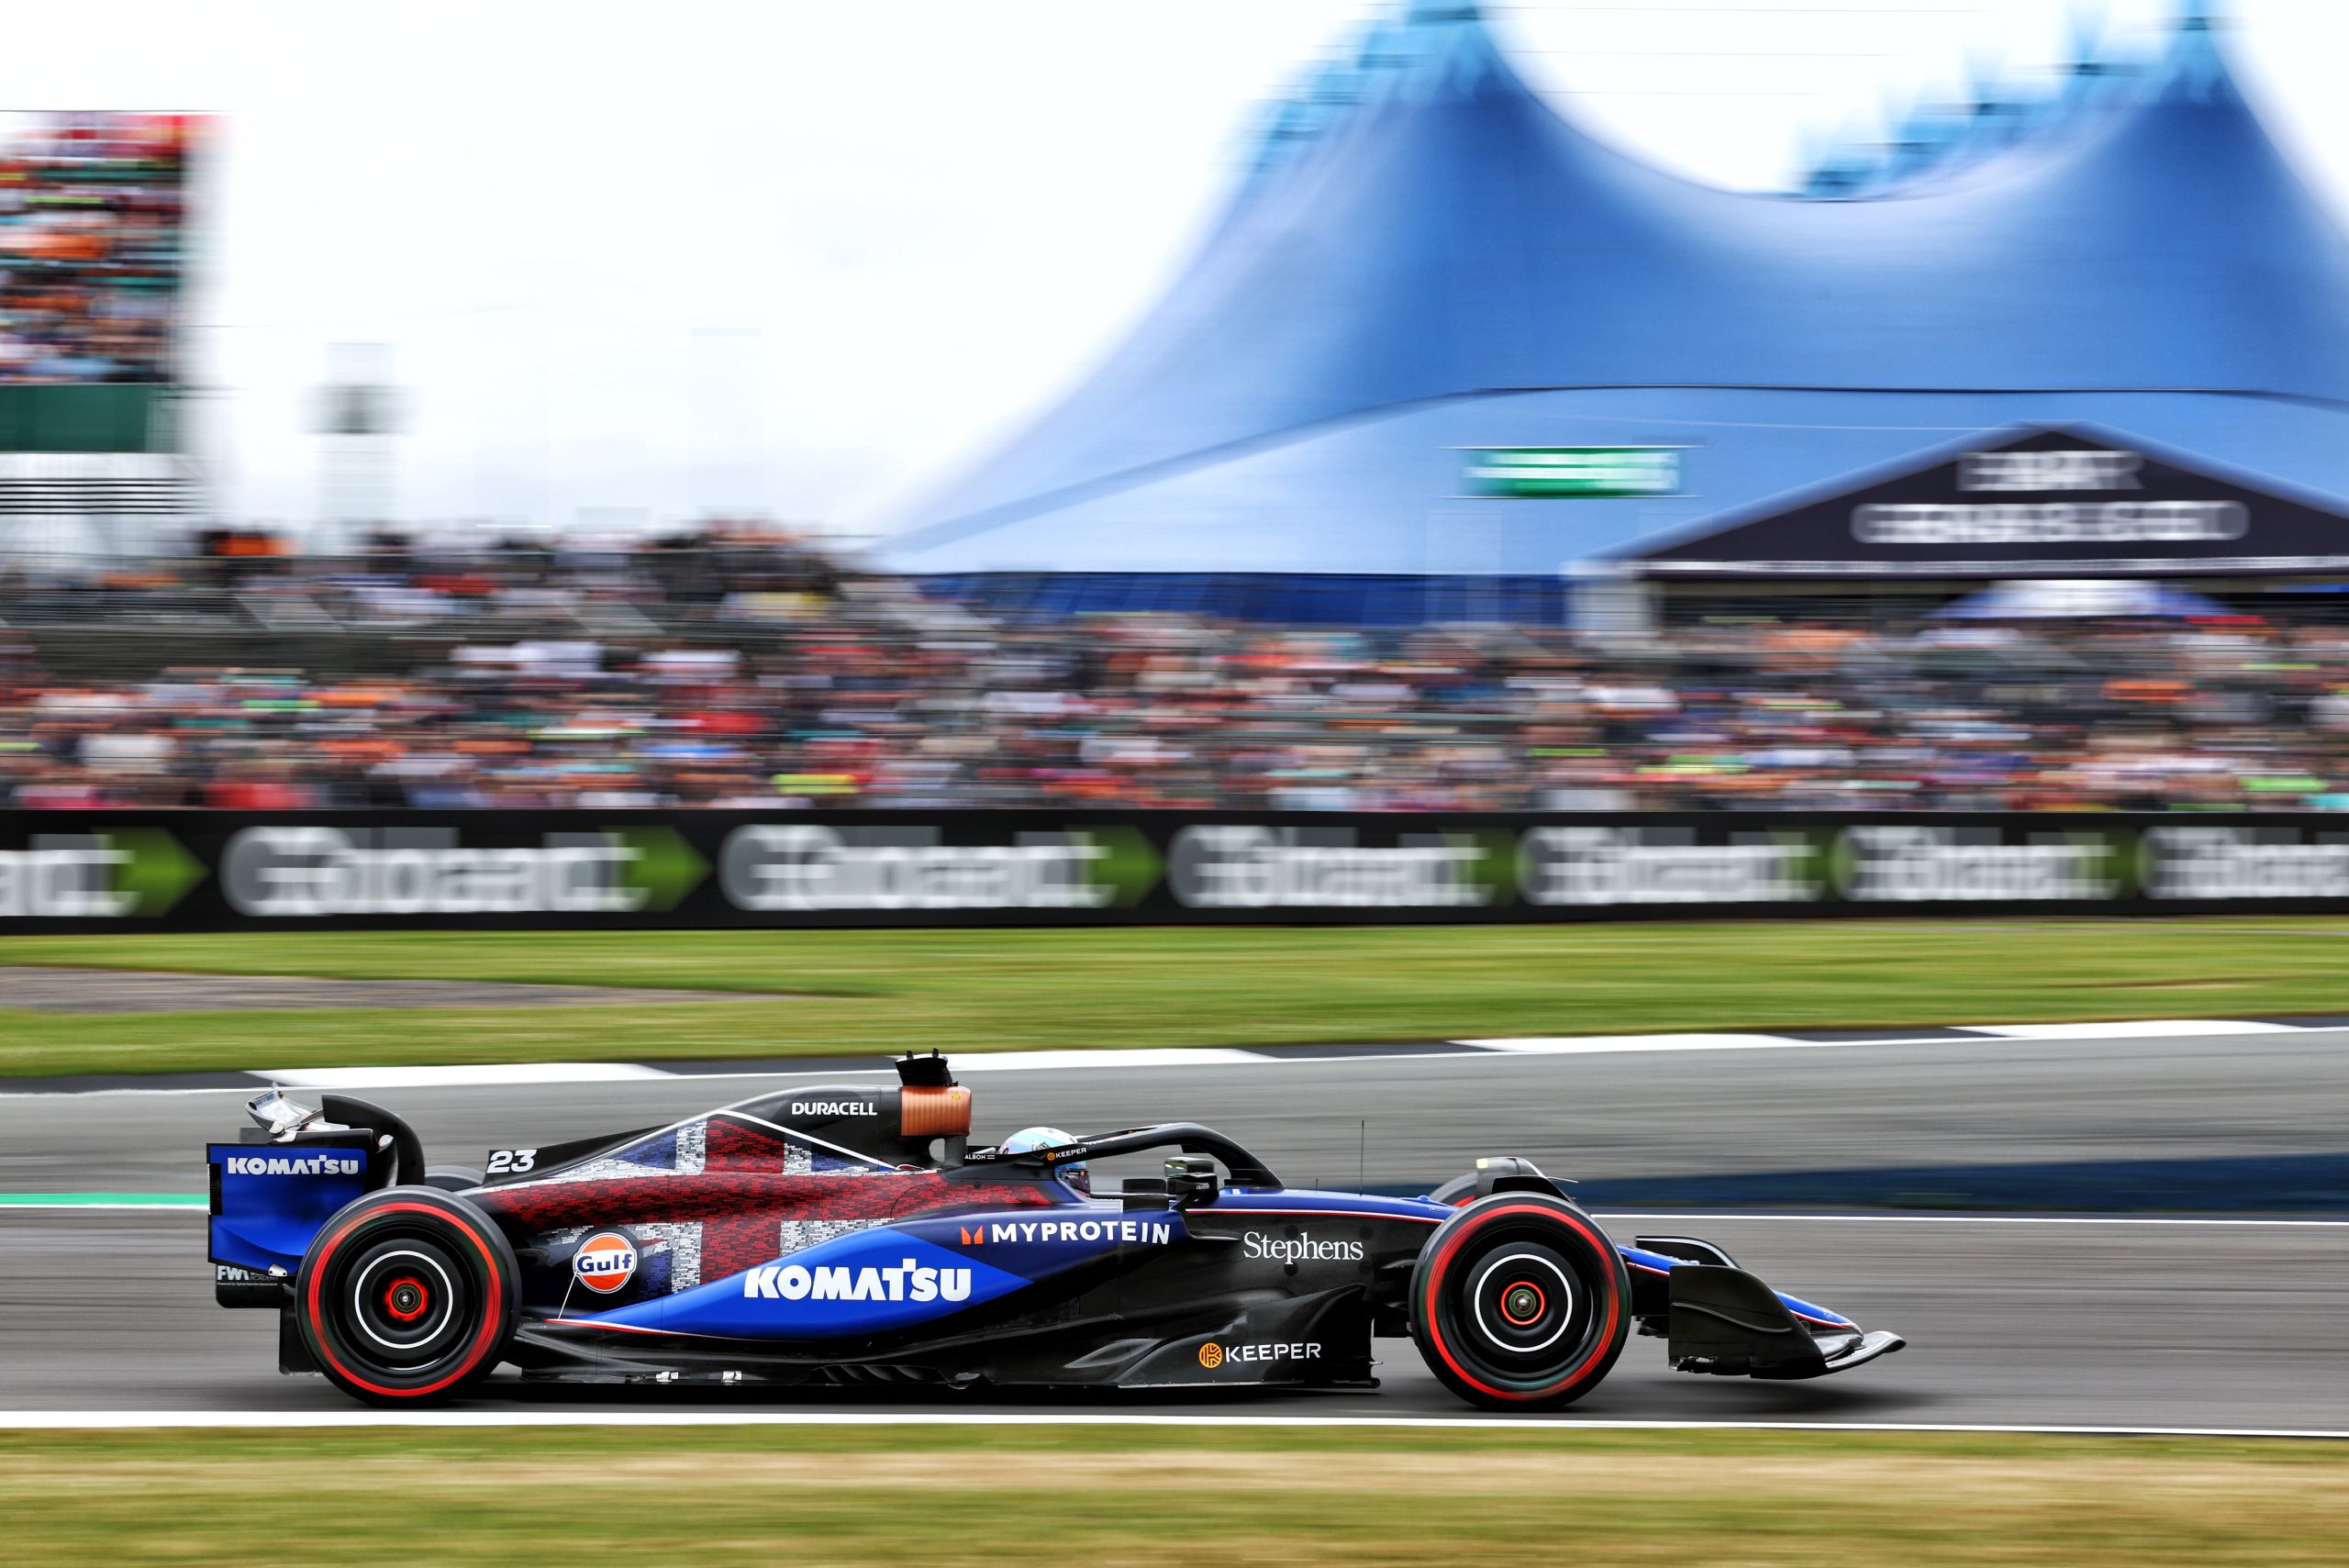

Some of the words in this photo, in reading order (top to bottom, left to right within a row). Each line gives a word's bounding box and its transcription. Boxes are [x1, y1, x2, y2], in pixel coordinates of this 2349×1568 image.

[791, 1101, 879, 1115] DURACELL
[487, 1149, 537, 1173] 23
[1055, 1147, 1087, 1159] KEEPER
[228, 1156, 358, 1174] KOMATSU
[992, 1220, 1170, 1245] MYPROTEIN
[1243, 1231, 1364, 1265] Stephens
[576, 1253, 632, 1273] Gulf
[744, 1258, 972, 1301] KOMATSU
[1226, 1342, 1321, 1363] KEEPER
